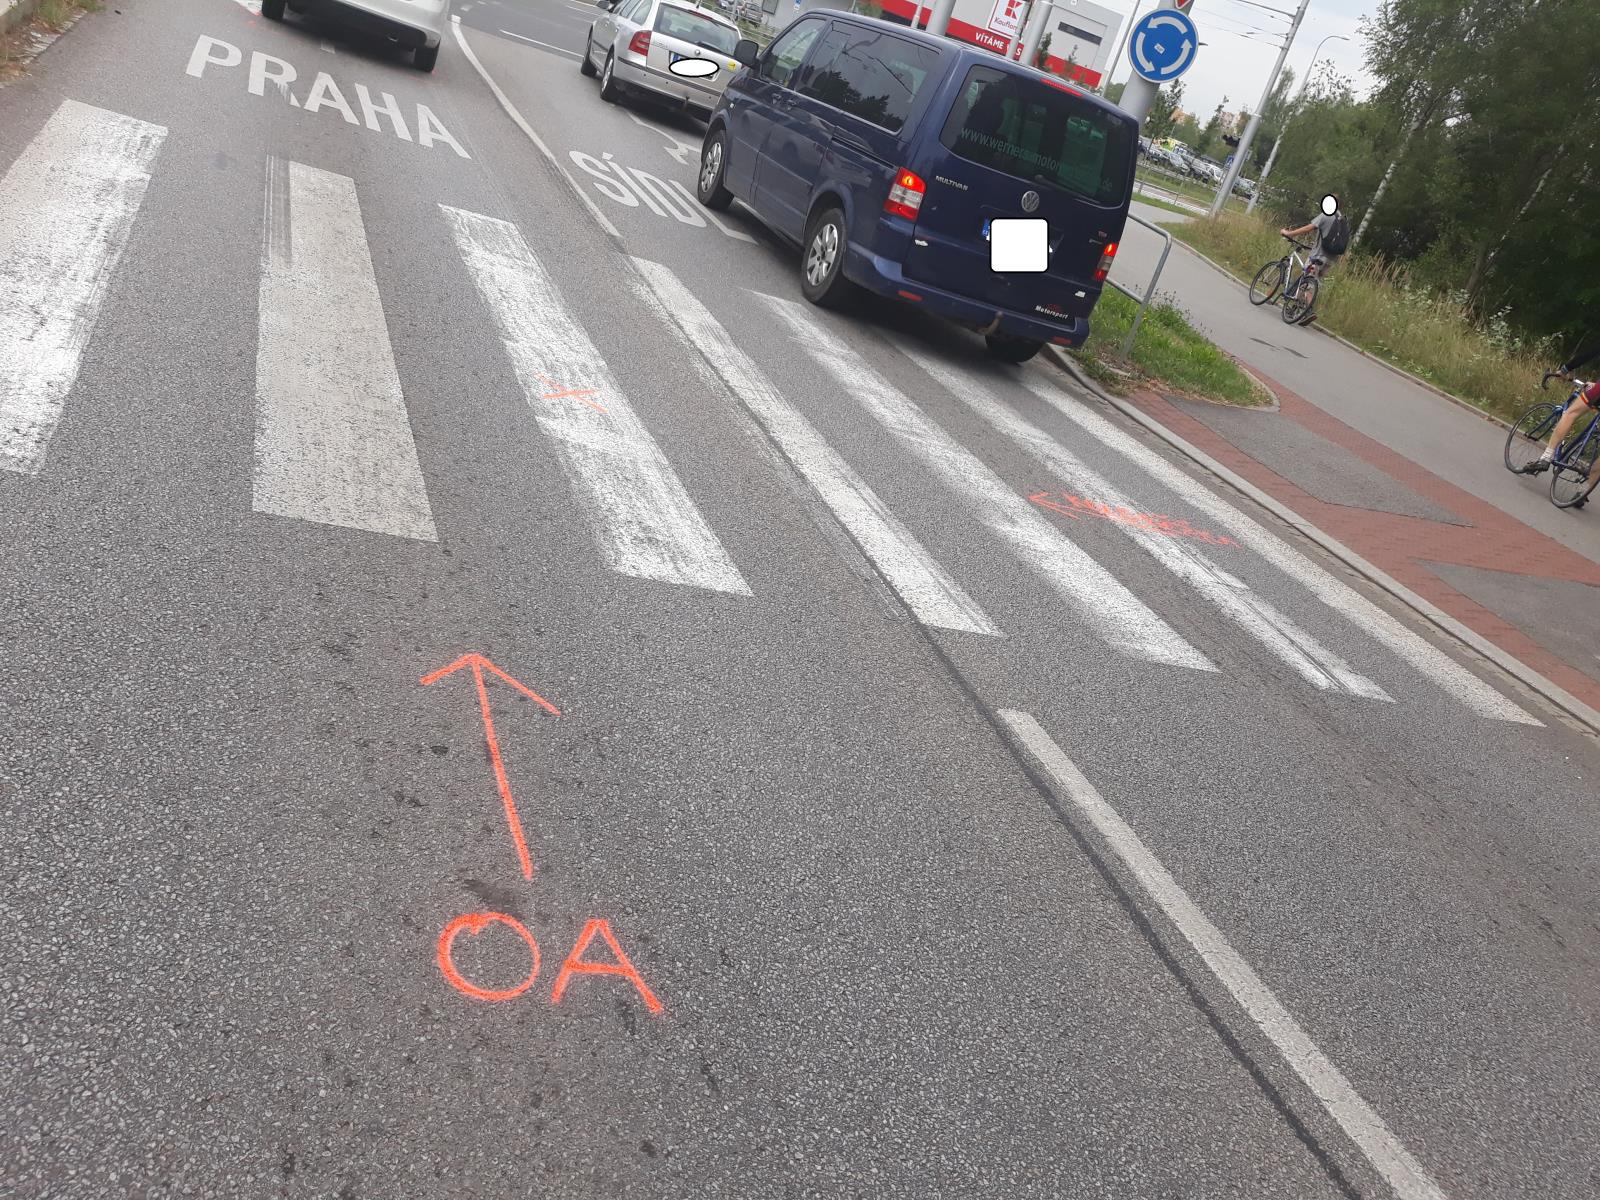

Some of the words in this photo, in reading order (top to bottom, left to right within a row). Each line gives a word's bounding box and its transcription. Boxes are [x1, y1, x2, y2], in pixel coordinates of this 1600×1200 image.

[975, 32, 1004, 49] VÍTÁME
[993, 16, 1018, 31] Kauflan
[185, 33, 472, 160] PRAHA
[569, 151, 760, 245] SÍDL
